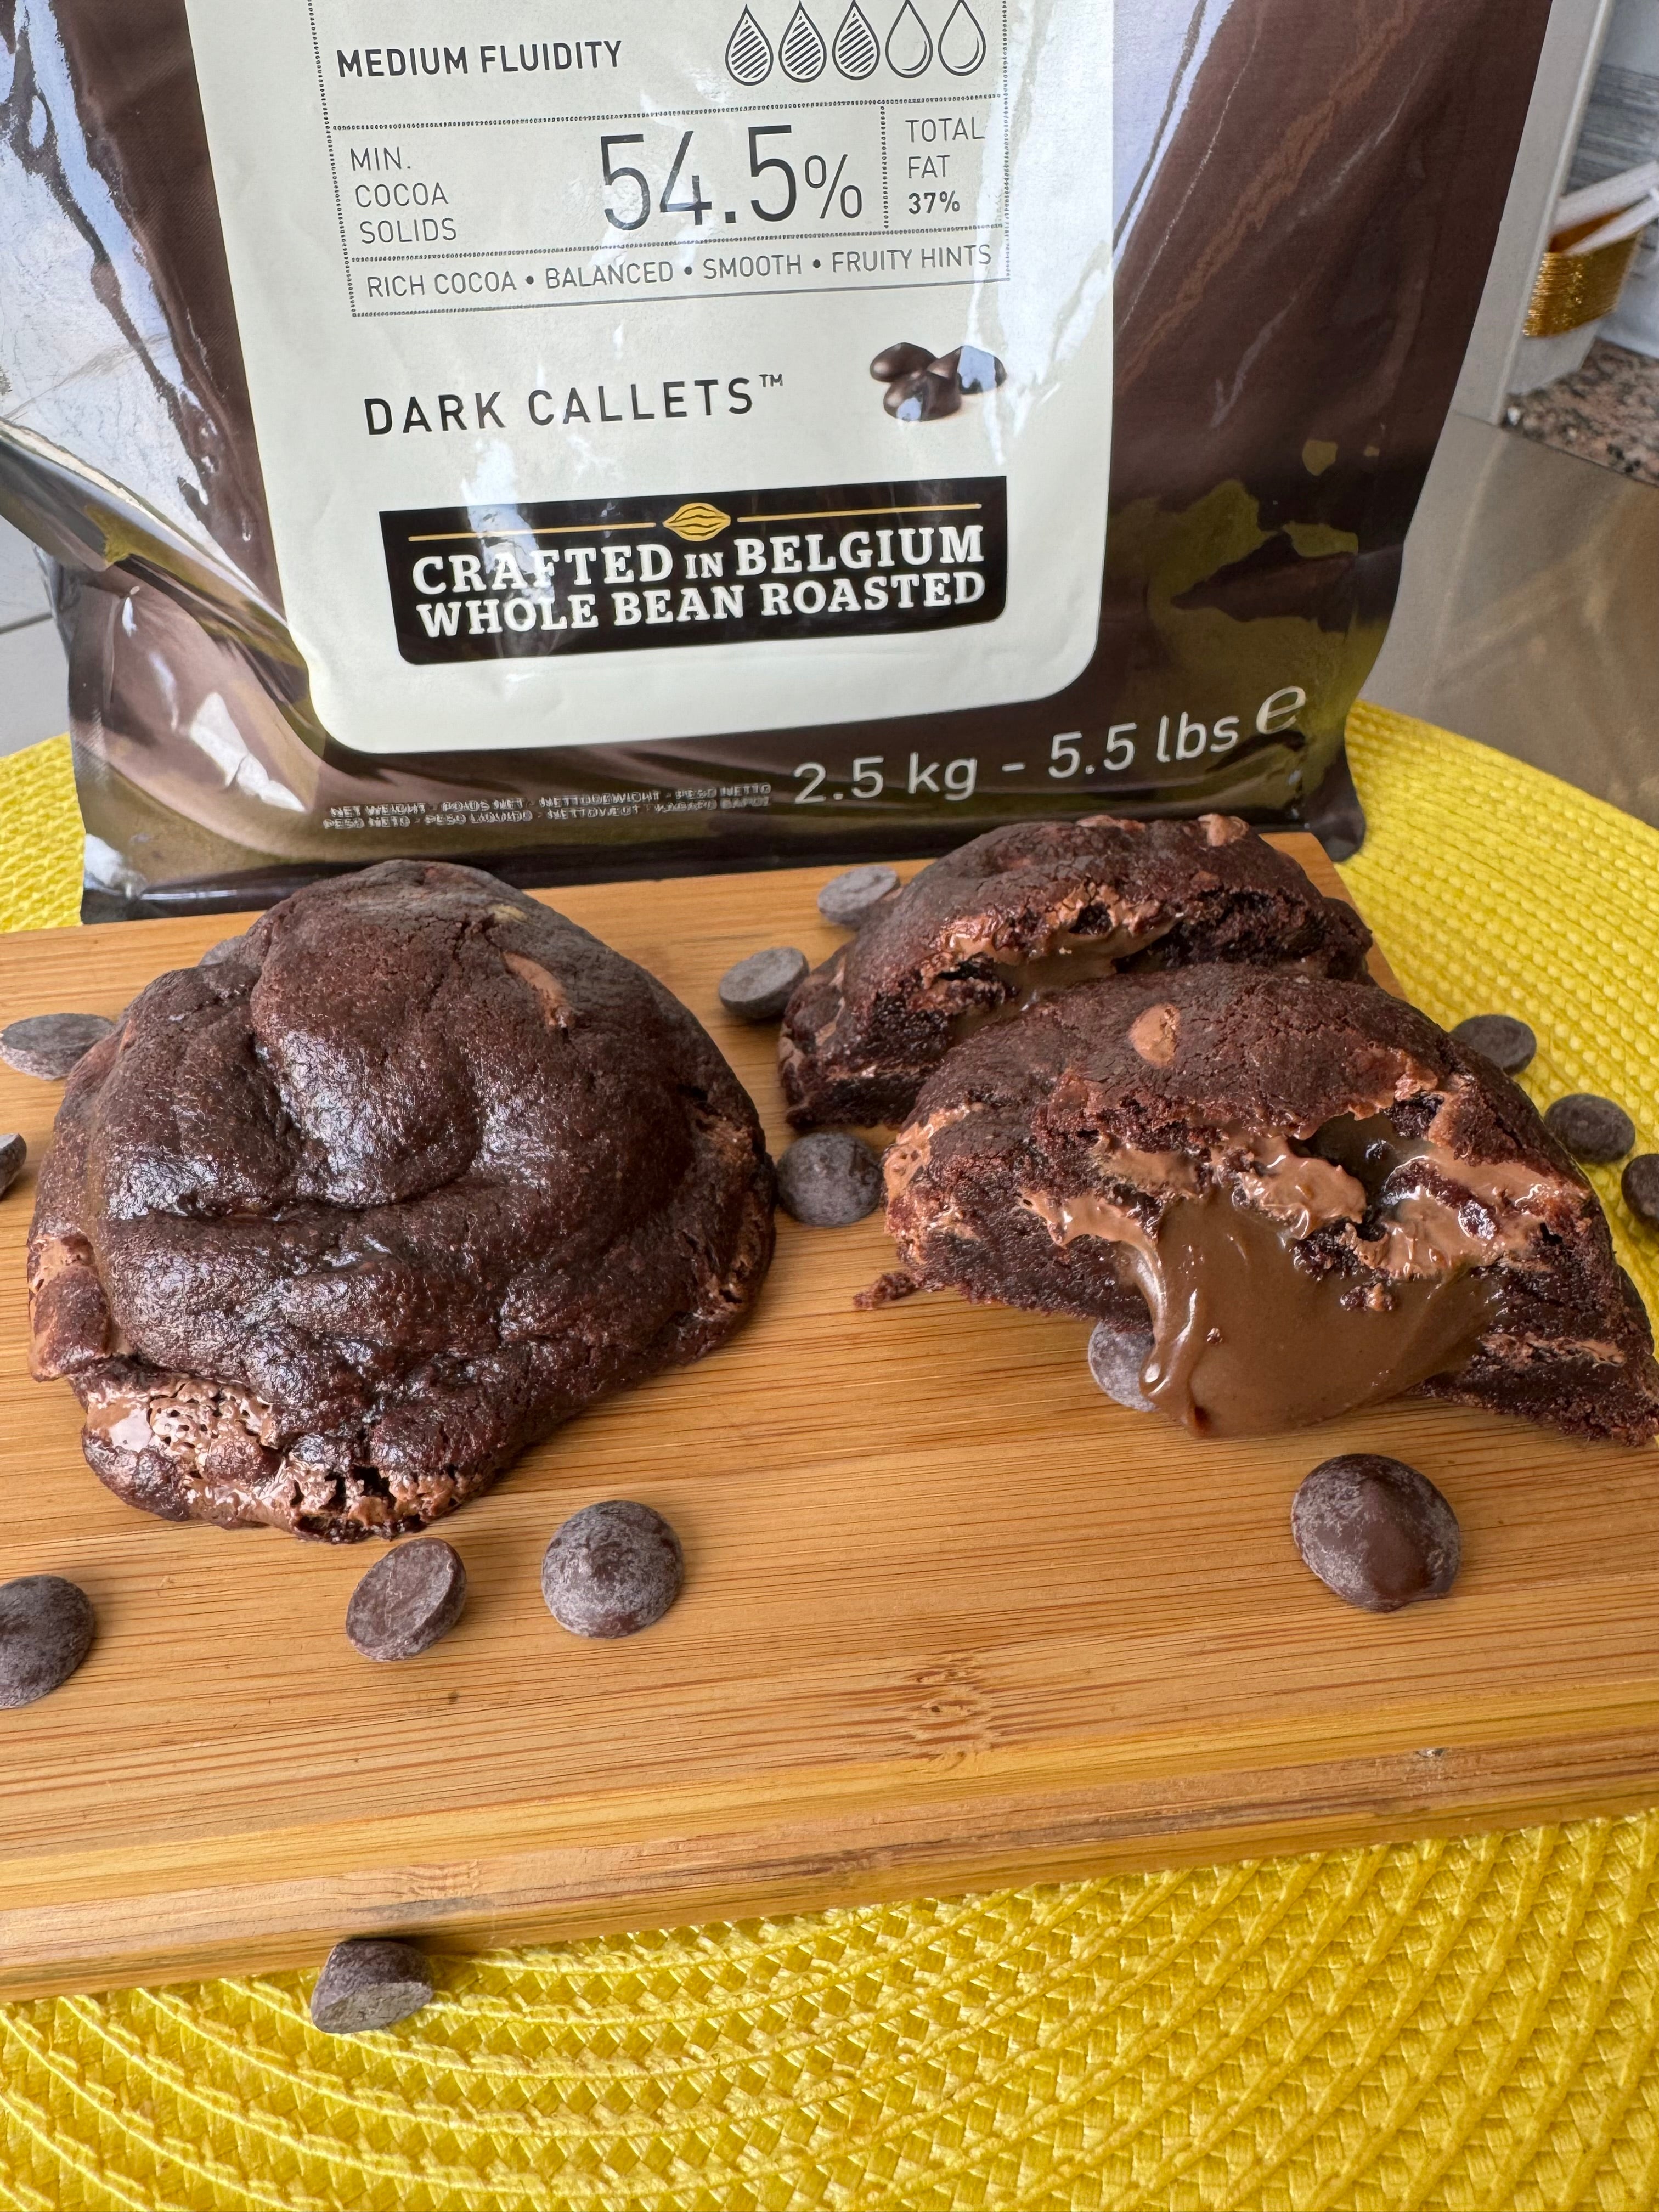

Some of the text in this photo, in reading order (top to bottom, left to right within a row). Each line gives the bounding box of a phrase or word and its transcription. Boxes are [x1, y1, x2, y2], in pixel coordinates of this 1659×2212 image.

[337, 40, 621, 77] MEDIUM FLUIDITY
[905, 117, 985, 143] TOTAL
[351, 146, 411, 171] MIN.
[908, 155, 950, 179] FAT
[601, 125, 862, 230] 54.5%
[355, 182, 448, 208] COCOA
[908, 190, 960, 214] 37%
[359, 218, 456, 244] SOLIDS
[368, 244, 991, 297] RICH COCOA BALANCED SMOOTH FRUITY HINTS
[364, 391, 505, 436] DARK
[412, 524, 984, 595] CRAFTED IN BELGIUM
[416, 571, 985, 637] WHOLE BEAN ROASTED
[793, 755, 884, 805] 2.5
[908, 752, 977, 801] kg
[1049, 723, 1136, 778] 5.5
[1156, 712, 1239, 763] lbs
[330, 806, 360, 817] NET
